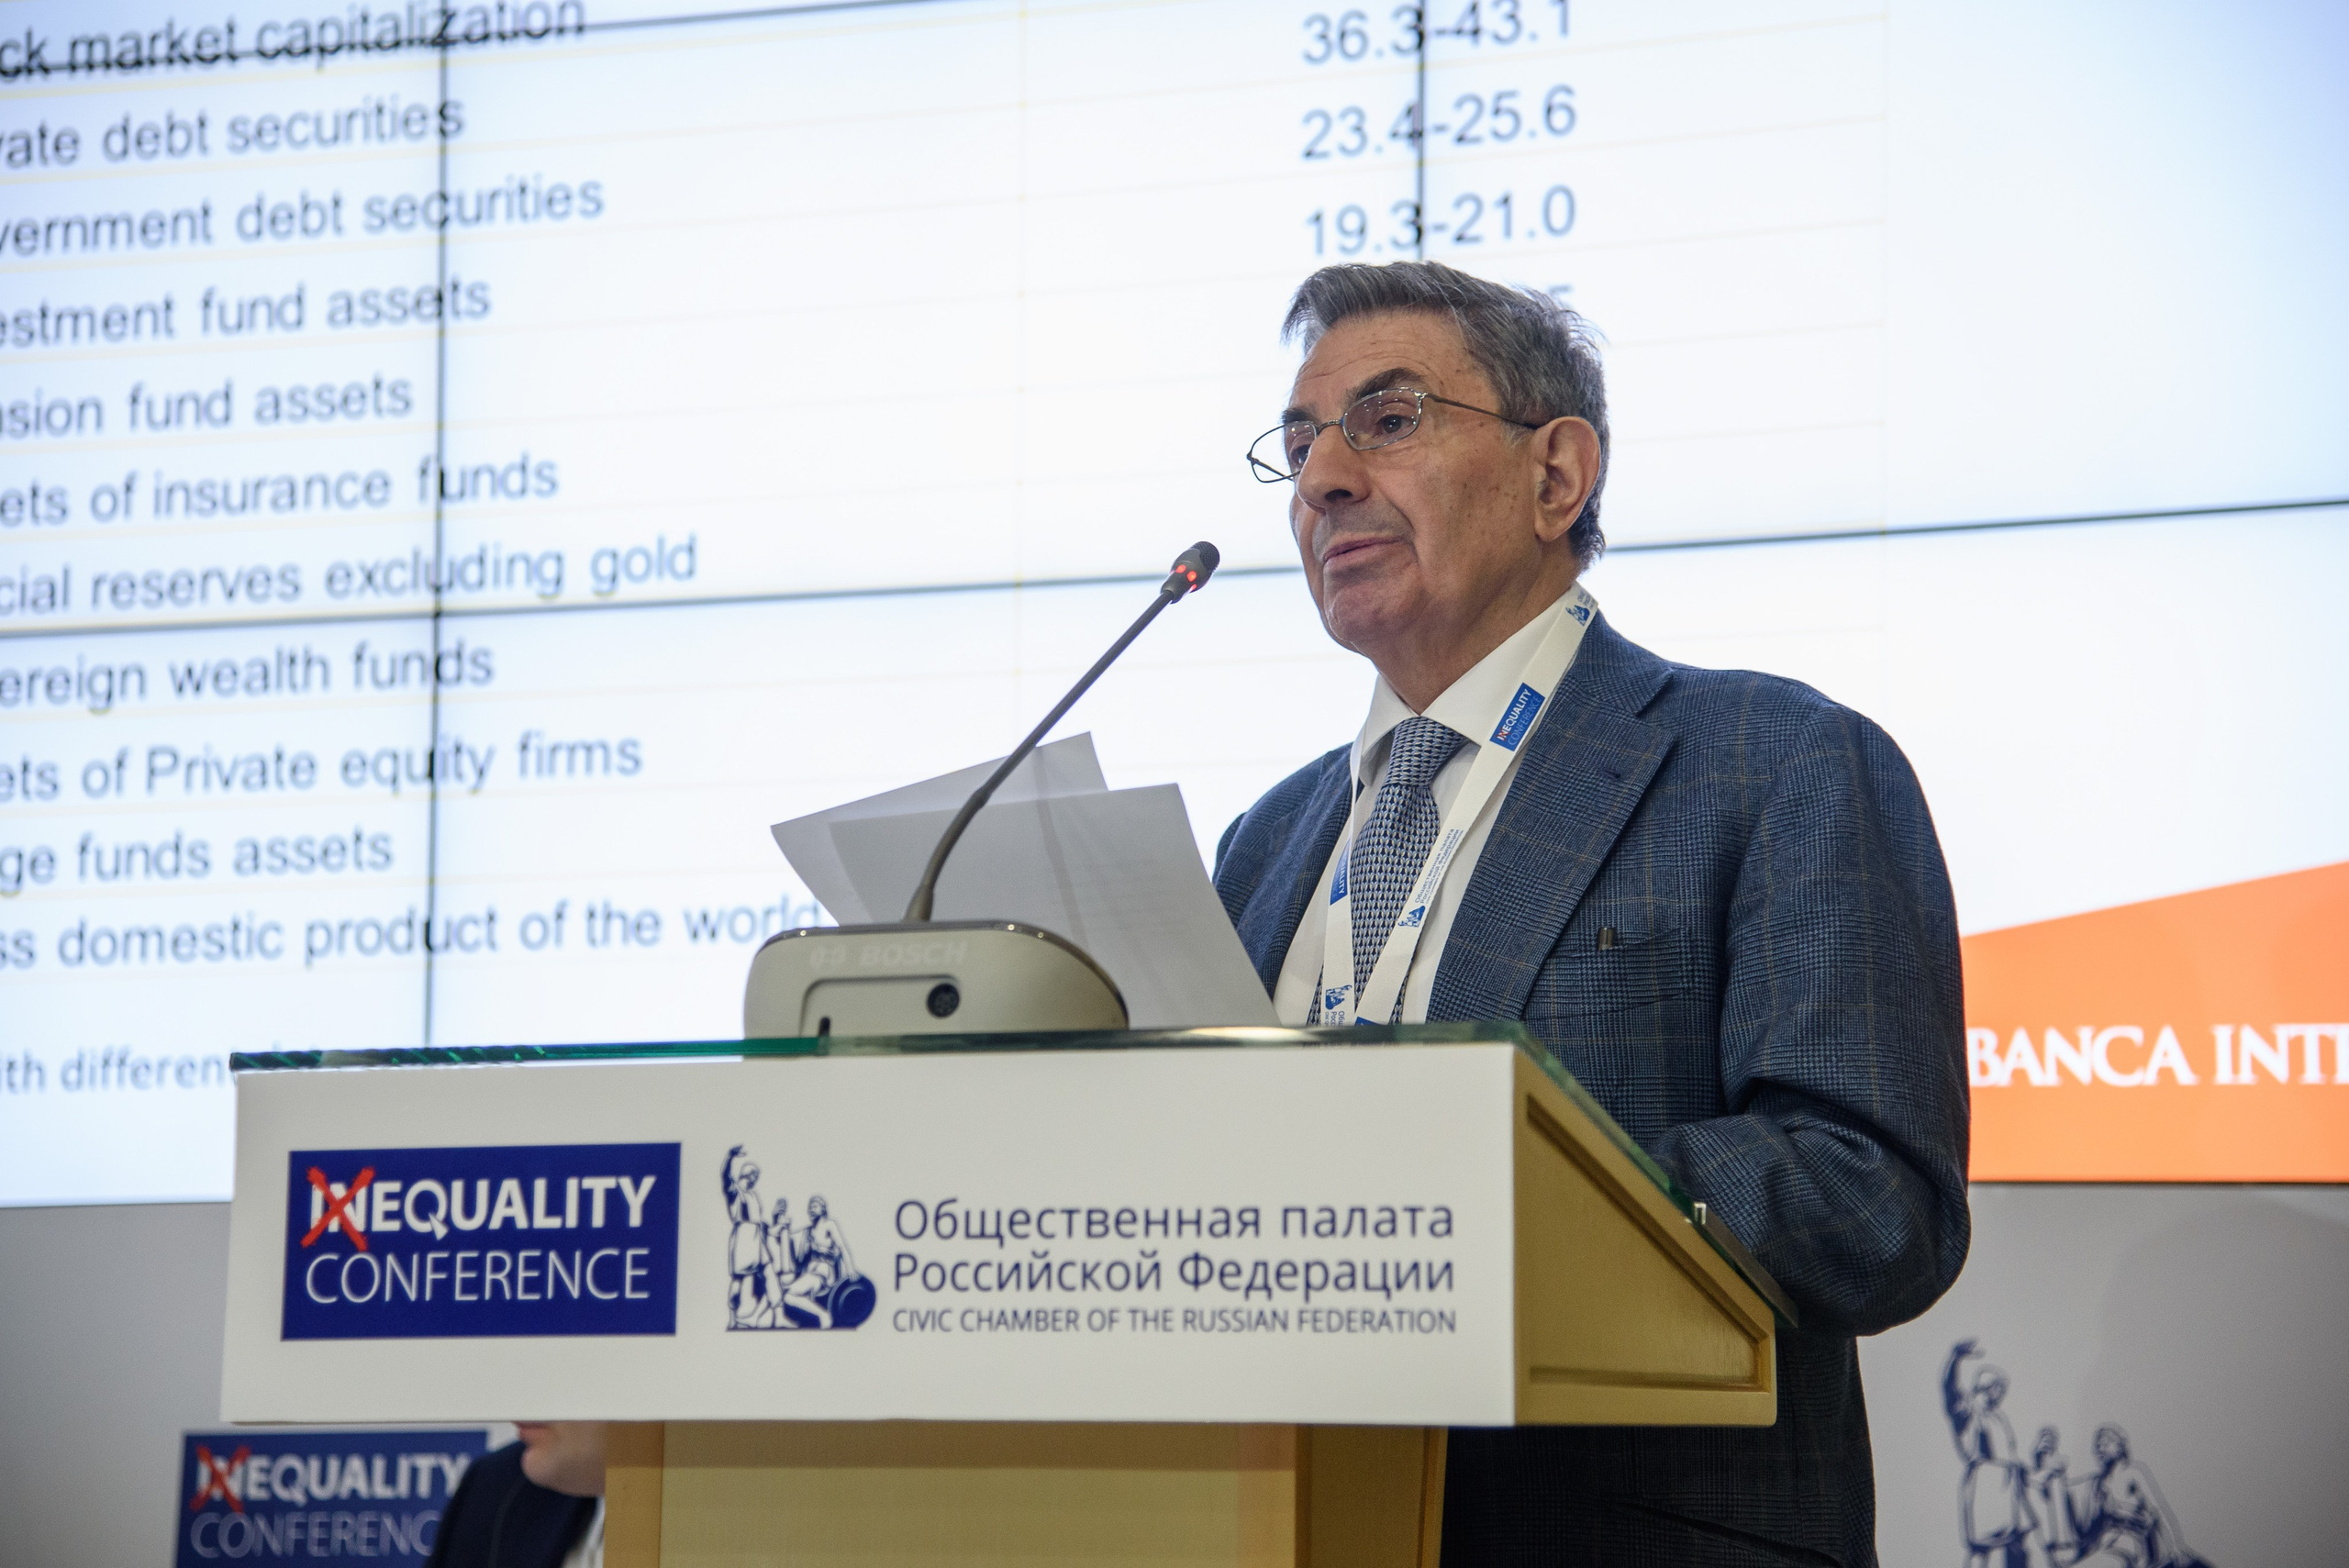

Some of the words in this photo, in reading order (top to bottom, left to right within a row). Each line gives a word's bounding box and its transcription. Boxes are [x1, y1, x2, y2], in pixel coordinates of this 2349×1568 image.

[69, 17, 239, 73] market
[255, 0, 587, 71] capitalization
[1302, 0, 1570, 65] 36.3-43.1
[0, 117, 80, 169] ate
[102, 106, 210, 163] debt
[227, 95, 465, 154] securities
[1302, 83, 1576, 161] 23.4-25.6
[236, 189, 345, 244] debt
[362, 173, 606, 235] securities
[1304, 184, 1576, 256] 19.3-21.0
[0, 290, 175, 350] stment
[198, 281, 305, 336] fund
[326, 276, 492, 330] assets
[0, 389, 104, 439] sion
[128, 378, 232, 428] fund
[253, 373, 413, 425] assets
[91, 469, 139, 521] of
[152, 466, 392, 519] insurance
[416, 451, 559, 503] funds
[92, 561, 301, 609] reserves
[324, 540, 566, 602] excluding
[590, 532, 698, 598] gold
[168, 644, 331, 698] wealth
[351, 637, 495, 688] funds
[1508, 695, 1542, 746] CONFERENCE
[82, 746, 129, 795] of
[145, 744, 317, 795] Private
[340, 734, 495, 797] equity
[518, 728, 643, 780] firms
[76, 830, 211, 881] funds
[233, 825, 394, 873] assets
[59, 912, 284, 968] domestic
[305, 906, 497, 971] product
[519, 897, 568, 951] of
[584, 899, 662, 948] the
[862, 940, 968, 964] BOSCH
[60, 1043, 228, 1092] differen
[1966, 1023, 2200, 1087] BANCA
[894, 1197, 1261, 1249] Общественная
[1281, 1206, 1453, 1240] палата
[306, 1248, 650, 1304] CONFERENCE
[894, 1248, 1162, 1293] Российской
[1178, 1250, 1454, 1303] Федерации
[892, 1309, 953, 1334] CIVIC
[960, 1309, 1080, 1333] CHAMBER
[1086, 1309, 1119, 1333] OF
[1127, 1309, 1174, 1333] THE
[1183, 1309, 1288, 1333] RUSSIAN
[1297, 1309, 1456, 1334] FEDERATION
